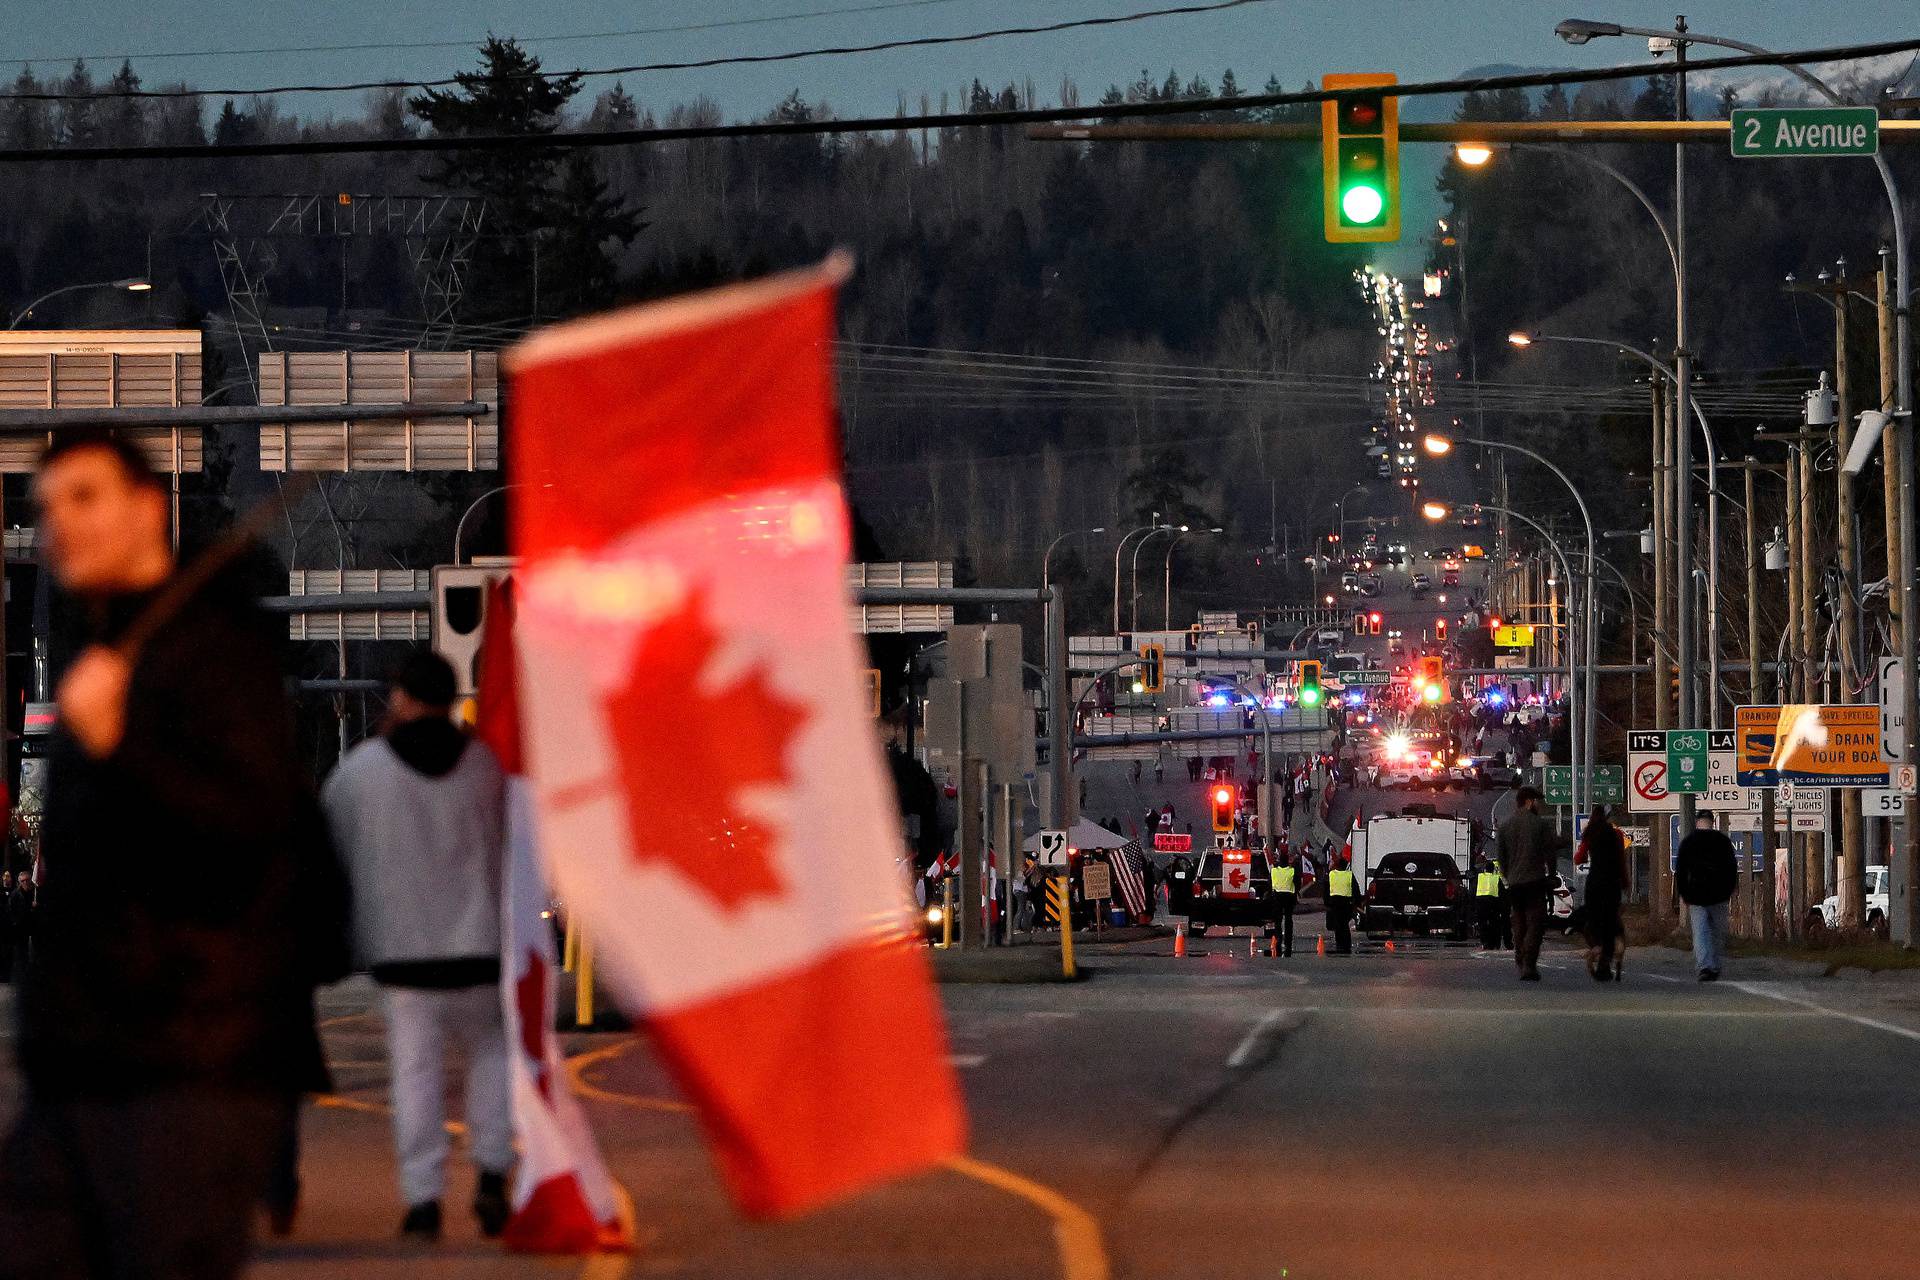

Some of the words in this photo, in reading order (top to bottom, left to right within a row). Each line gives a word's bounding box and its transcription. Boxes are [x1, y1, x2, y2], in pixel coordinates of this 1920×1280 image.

[1744, 118, 1761, 148] 2
[1775, 118, 1867, 148] Avenue
[1364, 673, 1389, 683] Avenue
[1843, 711, 1874, 720] SPECIES
[1633, 735, 1660, 748] IT'S
[1712, 735, 1736, 747] LA
[1835, 733, 1875, 745] DRAIN
[1812, 751, 1845, 763] YOUR
[1852, 751, 1879, 763] BOA
[1795, 792, 1823, 800] EHICLES
[1798, 802, 1822, 810] LIGHTS
[1880, 795, 1902, 810] 55
